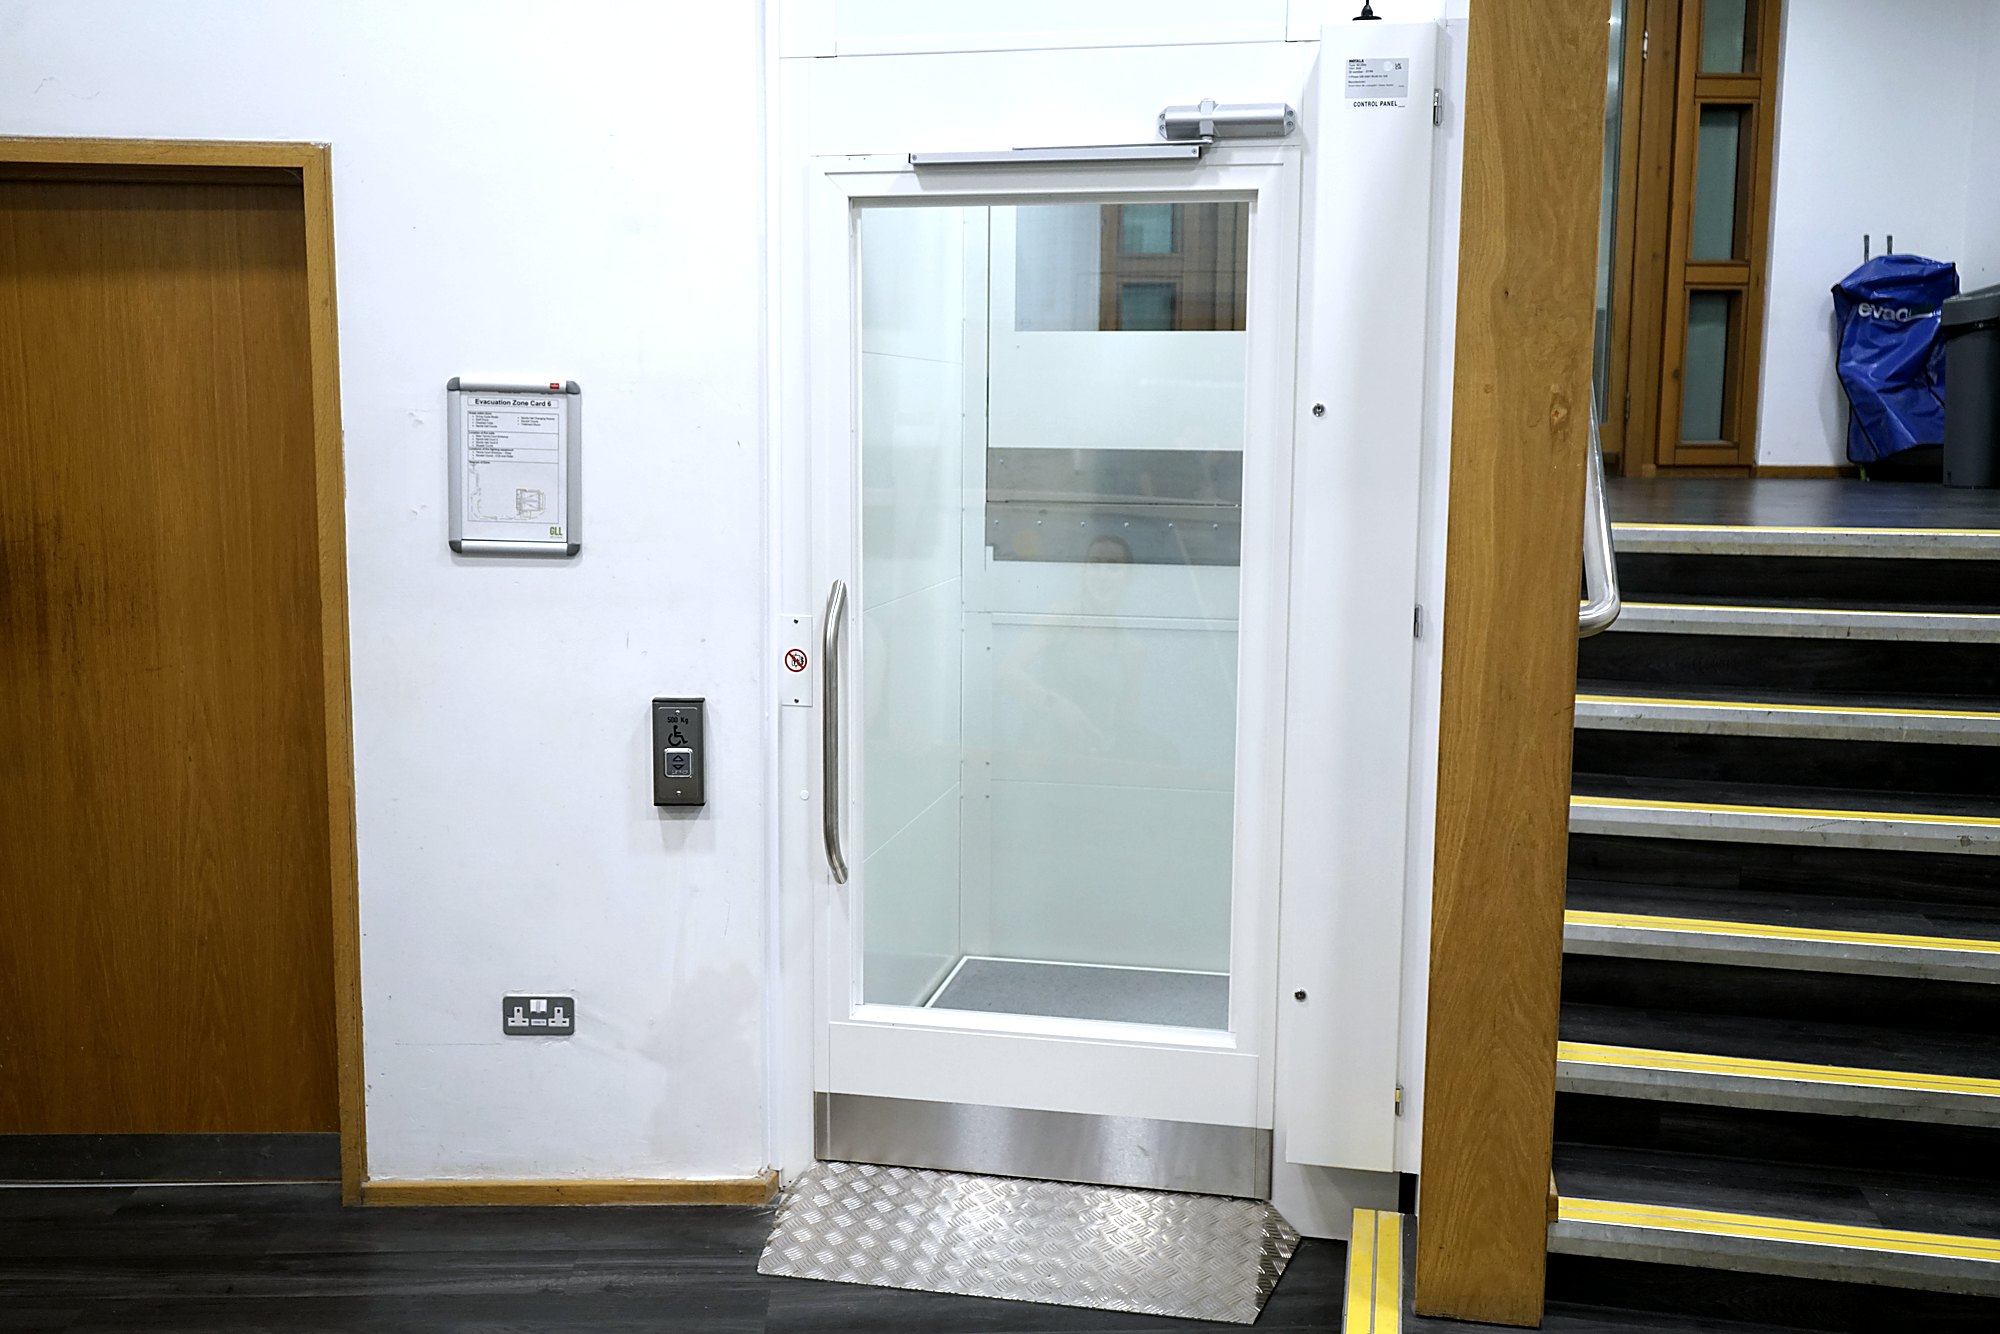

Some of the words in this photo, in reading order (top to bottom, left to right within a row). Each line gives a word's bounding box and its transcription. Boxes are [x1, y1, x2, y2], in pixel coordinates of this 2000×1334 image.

[475, 398, 511, 406] Evacuation
[550, 526, 563, 536] GLL
[667, 716, 679, 724] 500
